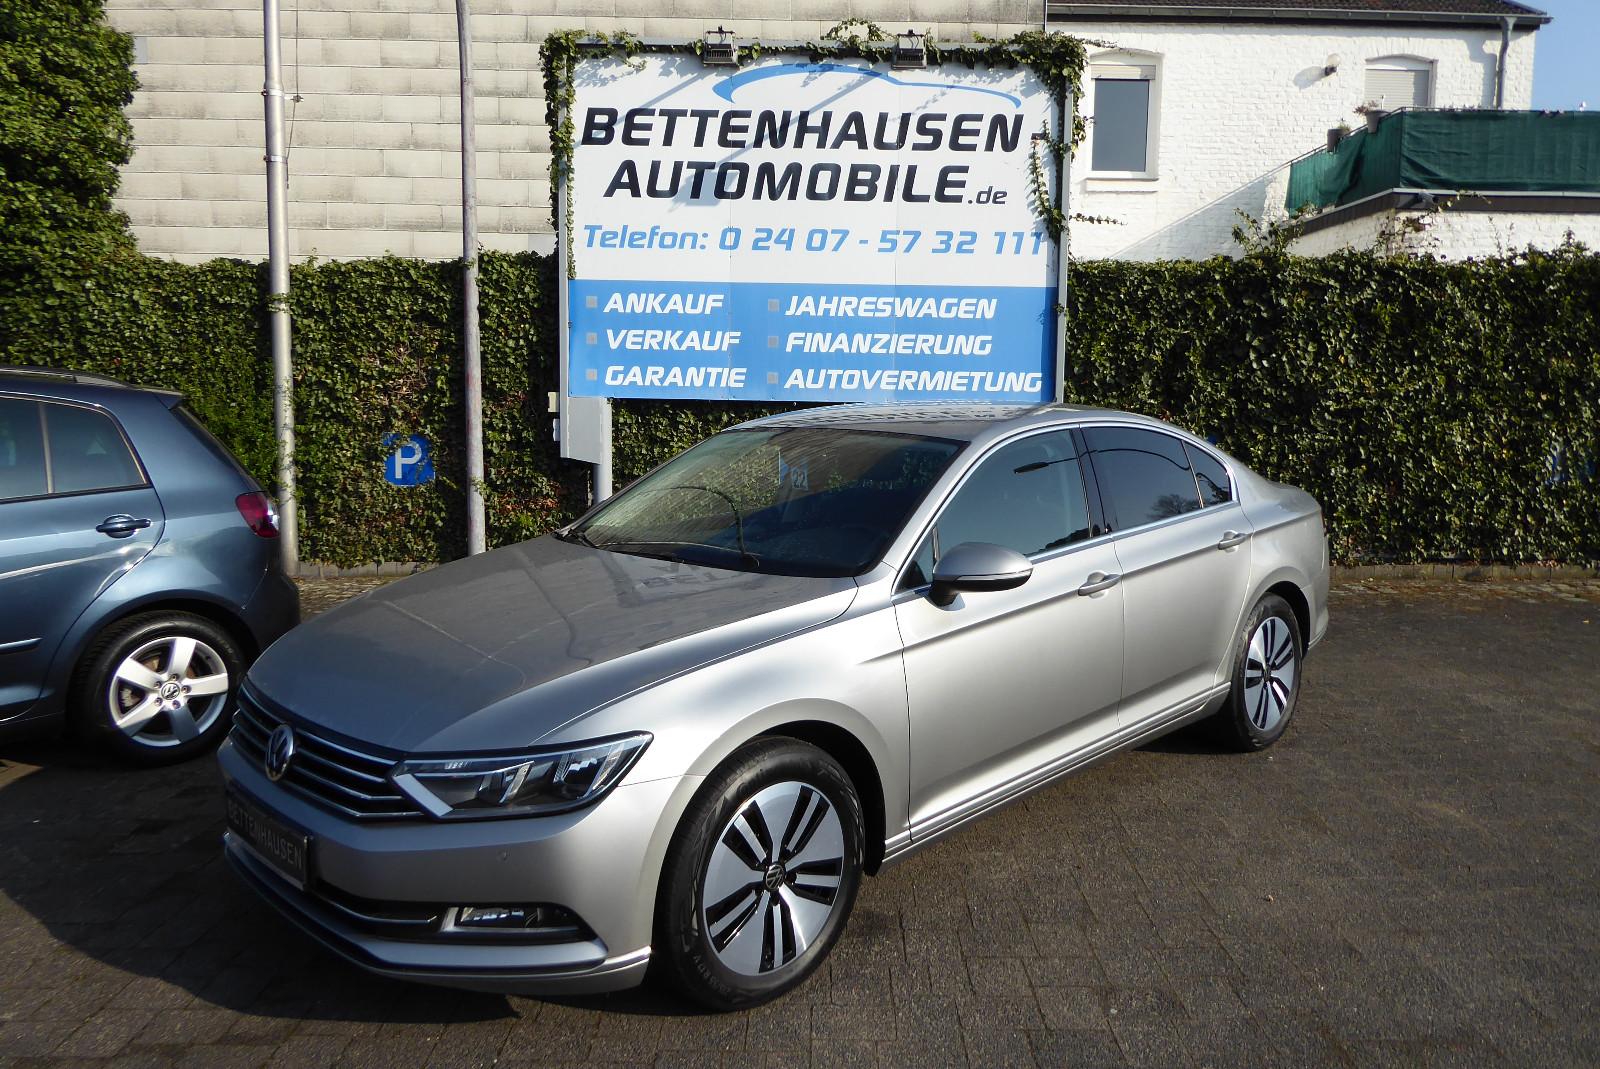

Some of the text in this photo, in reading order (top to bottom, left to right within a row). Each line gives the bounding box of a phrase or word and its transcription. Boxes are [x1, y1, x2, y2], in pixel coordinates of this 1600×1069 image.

[584, 224, 709, 250] Telefon:
[719, 227, 742, 251] 0
[751, 227, 795, 252] 24
[805, 228, 850, 252] 07
[878, 229, 922, 253] 57
[931, 231, 978, 254] 32
[994, 231, 1044, 255] 111
[604, 293, 725, 315] ANKAUF
[785, 296, 998, 319] JAHRESWAGEN
[606, 329, 741, 352] VERKAUF
[785, 333, 993, 356] FINANZIERUNG
[605, 366, 747, 388] GARANTIE
[784, 369, 1043, 393] AUTOVERMIETUNG
[394, 440, 422, 479] P
